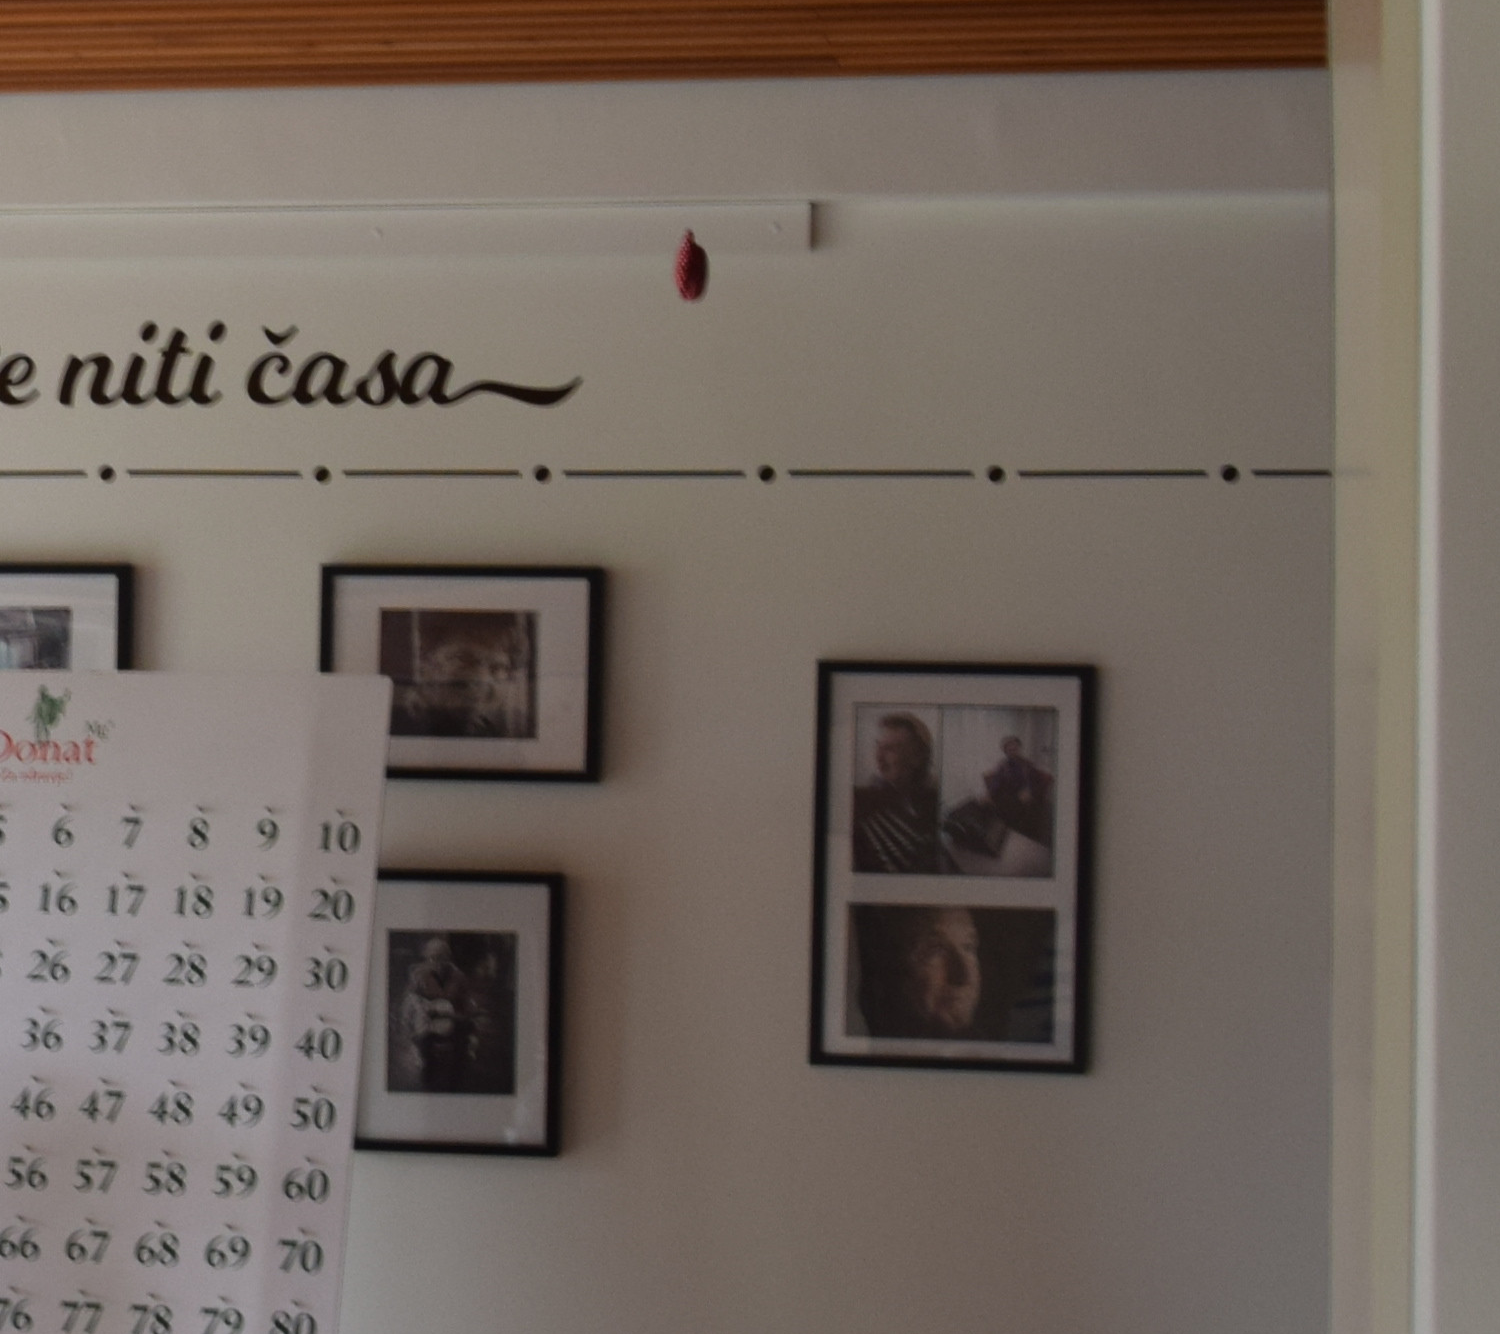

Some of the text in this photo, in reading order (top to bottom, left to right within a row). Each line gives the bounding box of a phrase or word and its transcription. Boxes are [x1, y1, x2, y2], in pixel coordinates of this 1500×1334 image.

[57, 315, 227, 408] niti
[246, 321, 584, 408] časa
[51, 815, 75, 848] 6
[120, 816, 144, 849] 7
[187, 817, 210, 851] 8
[256, 818, 280, 851] 9
[319, 821, 361, 855] 10
[38, 882, 79, 916] 16
[106, 884, 148, 917] 17
[174, 885, 214, 919] 18
[242, 886, 285, 919] 19
[307, 888, 356, 924] 20
[25, 949, 71, 984] 26
[94, 951, 141, 985] 27
[162, 953, 207, 987] 28
[230, 954, 278, 988] 29
[304, 957, 350, 992] 30
[20, 1018, 64, 1052] 36
[88, 1019, 134, 1054] 37
[157, 1021, 201, 1056] 38
[226, 1023, 272, 1058] 39
[294, 1027, 343, 1062] 40
[10, 1087, 57, 1122] 46
[78, 1089, 127, 1125] 47
[147, 1091, 194, 1126] 48
[217, 1094, 265, 1128] 49
[289, 1097, 337, 1133] 50
[4, 1156, 49, 1191] 56
[73, 1159, 119, 1193] 57
[141, 1161, 187, 1196] 58
[212, 1164, 259, 1199] 59
[281, 1168, 331, 1204] 60
[64, 1229, 111, 1265] 67
[133, 1232, 180, 1267] 68
[203, 1235, 252, 1269] 69
[277, 1238, 324, 1275] 70
